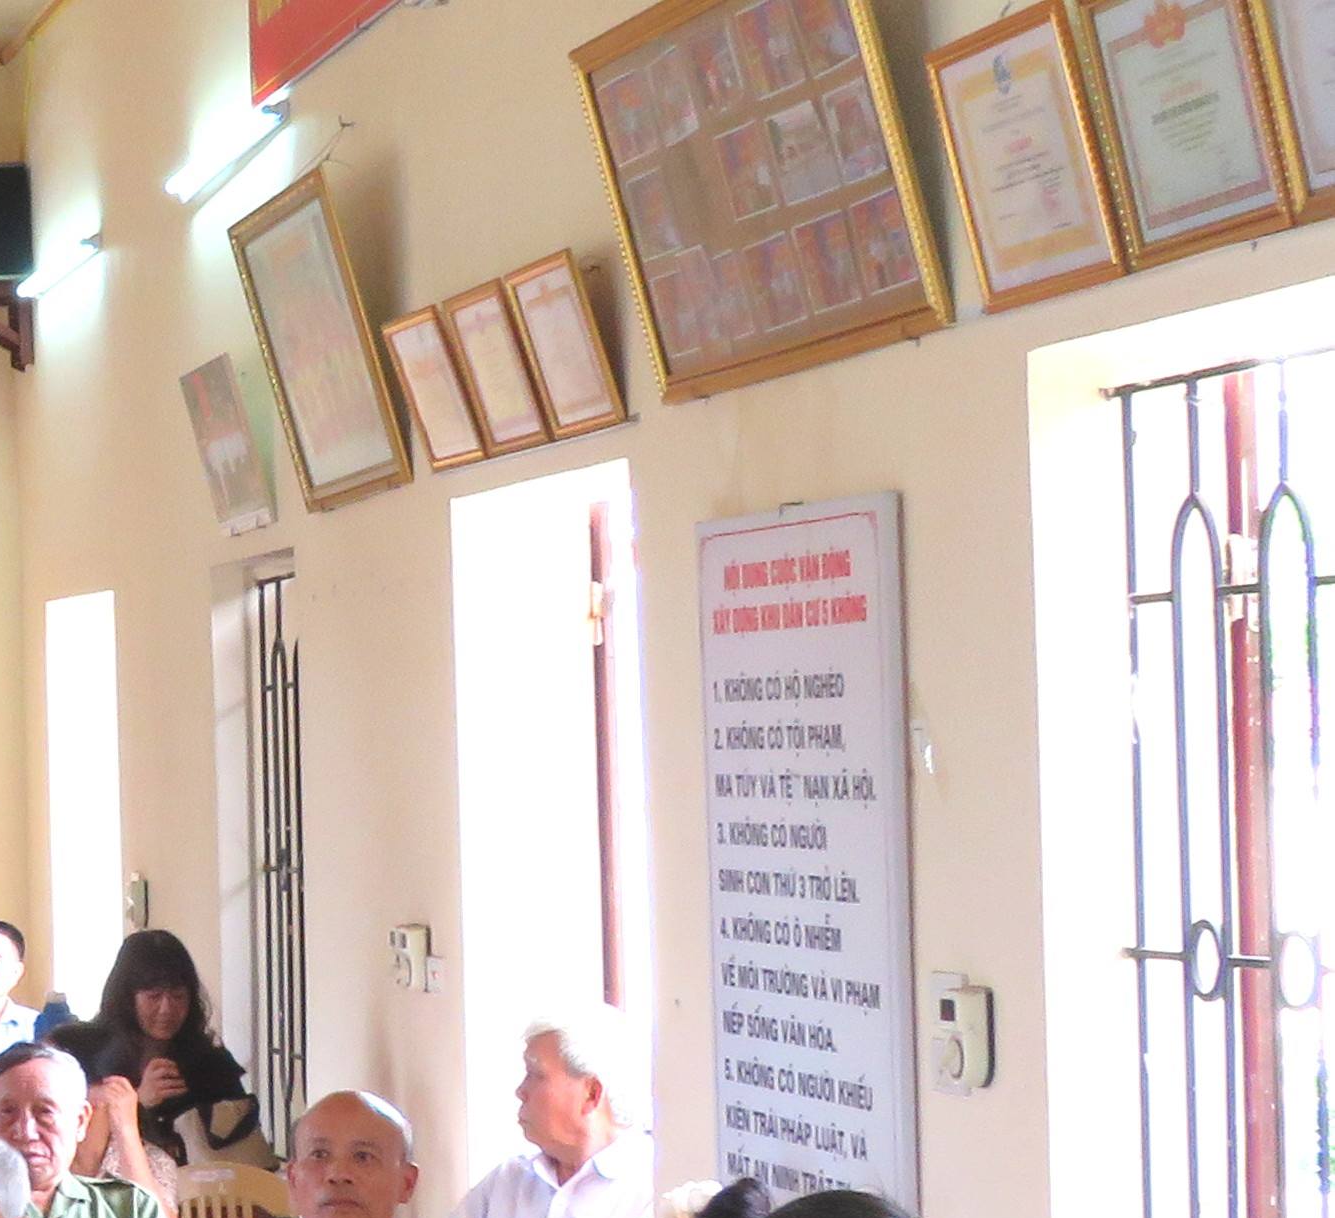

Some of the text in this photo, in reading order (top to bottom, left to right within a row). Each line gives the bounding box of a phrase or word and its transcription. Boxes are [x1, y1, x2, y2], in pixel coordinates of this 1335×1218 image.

[724, 671, 763, 702] KHÔNG
[766, 669, 782, 700] CÓ
[784, 668, 801, 707] HỘ
[804, 666, 845, 699] NGHÈO
[714, 728, 724, 750] 2.
[726, 720, 766, 750] KHÔNG
[767, 718, 783, 750] CÓ
[786, 718, 805, 758] TỘI
[715, 773, 732, 798] MA
[735, 767, 757, 798] TÚY
[760, 768, 777, 799] VÀ
[803, 774, 830, 808] NẠN
[832, 767, 850, 800] XÃ
[717, 815, 827, 850] 3. KHÔNG CÓ NGƯỜI
[718, 868, 745, 893] SINH
[746, 870, 771, 896] CON
[773, 866, 797, 897] THỨ
[799, 875, 806, 899] 3
[809, 865, 832, 901] TRỞ
[719, 911, 842, 953] 4. KHÔNG CÓ Ô NHIỄM
[721, 954, 881, 1017] VỀ MÔI TRƯỜNG VÀ VI PHẠM
[722, 1001, 745, 1036] NẾP
[747, 1004, 779, 1042] SỐNG
[780, 1014, 807, 1047] VĂN
[724, 1056, 874, 1112] 5. KHÔNG CÓ NGƯỜI KHIẾU
[725, 1100, 751, 1138] KIỆN
[752, 1107, 779, 1140] TRÁI
[780, 1113, 812, 1146] PHÁP
[850, 1128, 868, 1161] VÀ
